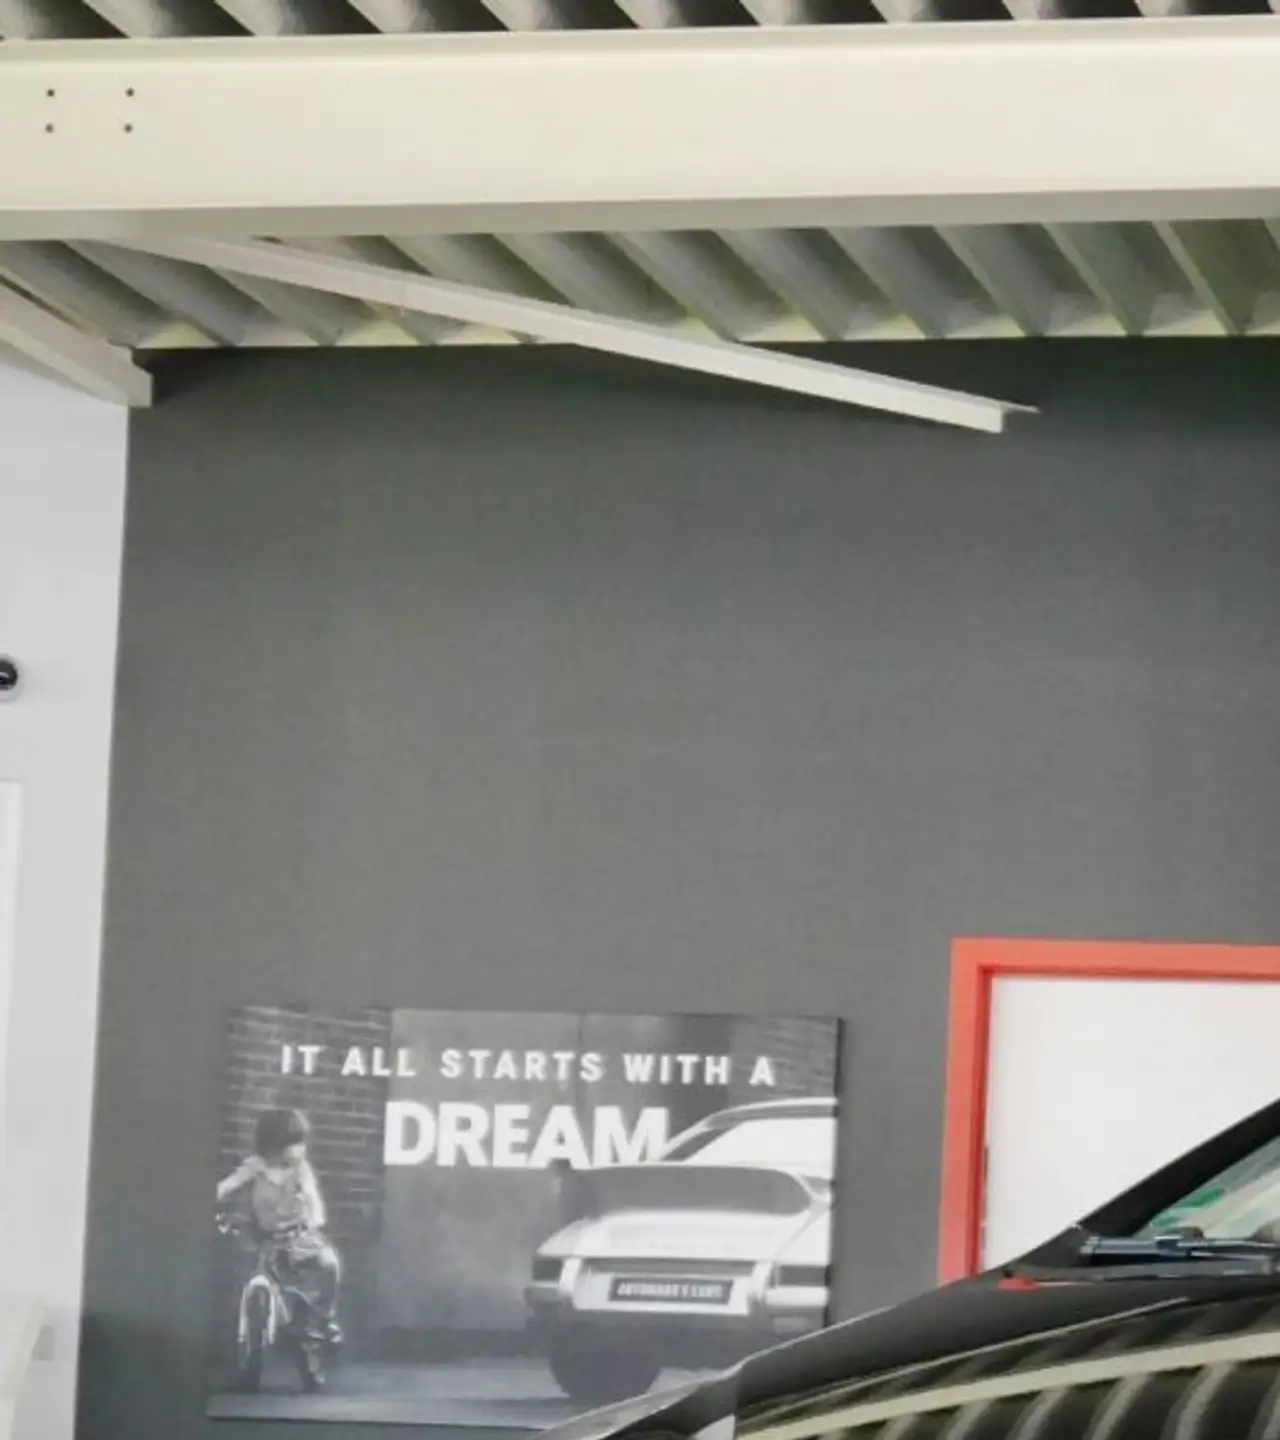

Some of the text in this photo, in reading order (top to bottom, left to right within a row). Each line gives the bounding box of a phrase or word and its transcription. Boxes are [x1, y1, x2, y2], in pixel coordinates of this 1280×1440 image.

[280, 1044, 776, 1086] IT ALL STARTS WITH A
[383, 1101, 671, 1169] DREAM
